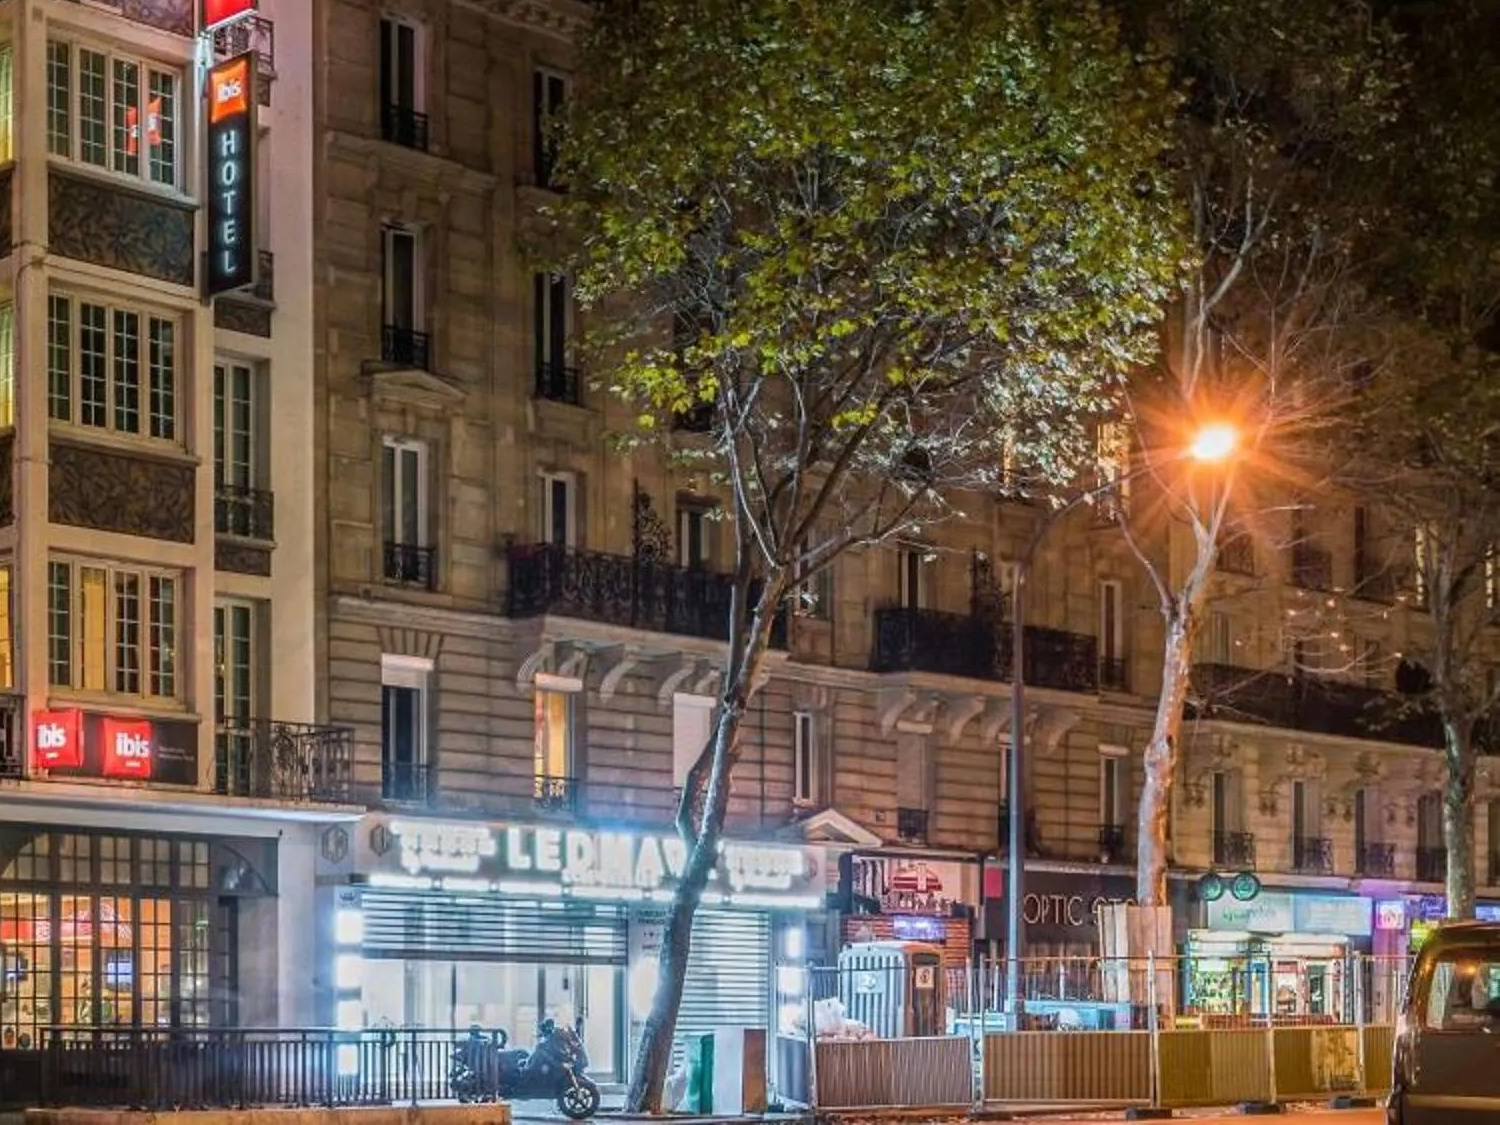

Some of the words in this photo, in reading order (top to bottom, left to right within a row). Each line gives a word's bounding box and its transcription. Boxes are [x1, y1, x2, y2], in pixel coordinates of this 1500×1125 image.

[221, 130, 237, 274] HOTEL
[37, 723, 67, 749] ibis
[115, 732, 149, 758] ibis
[1023, 894, 1083, 926] OPTIC
